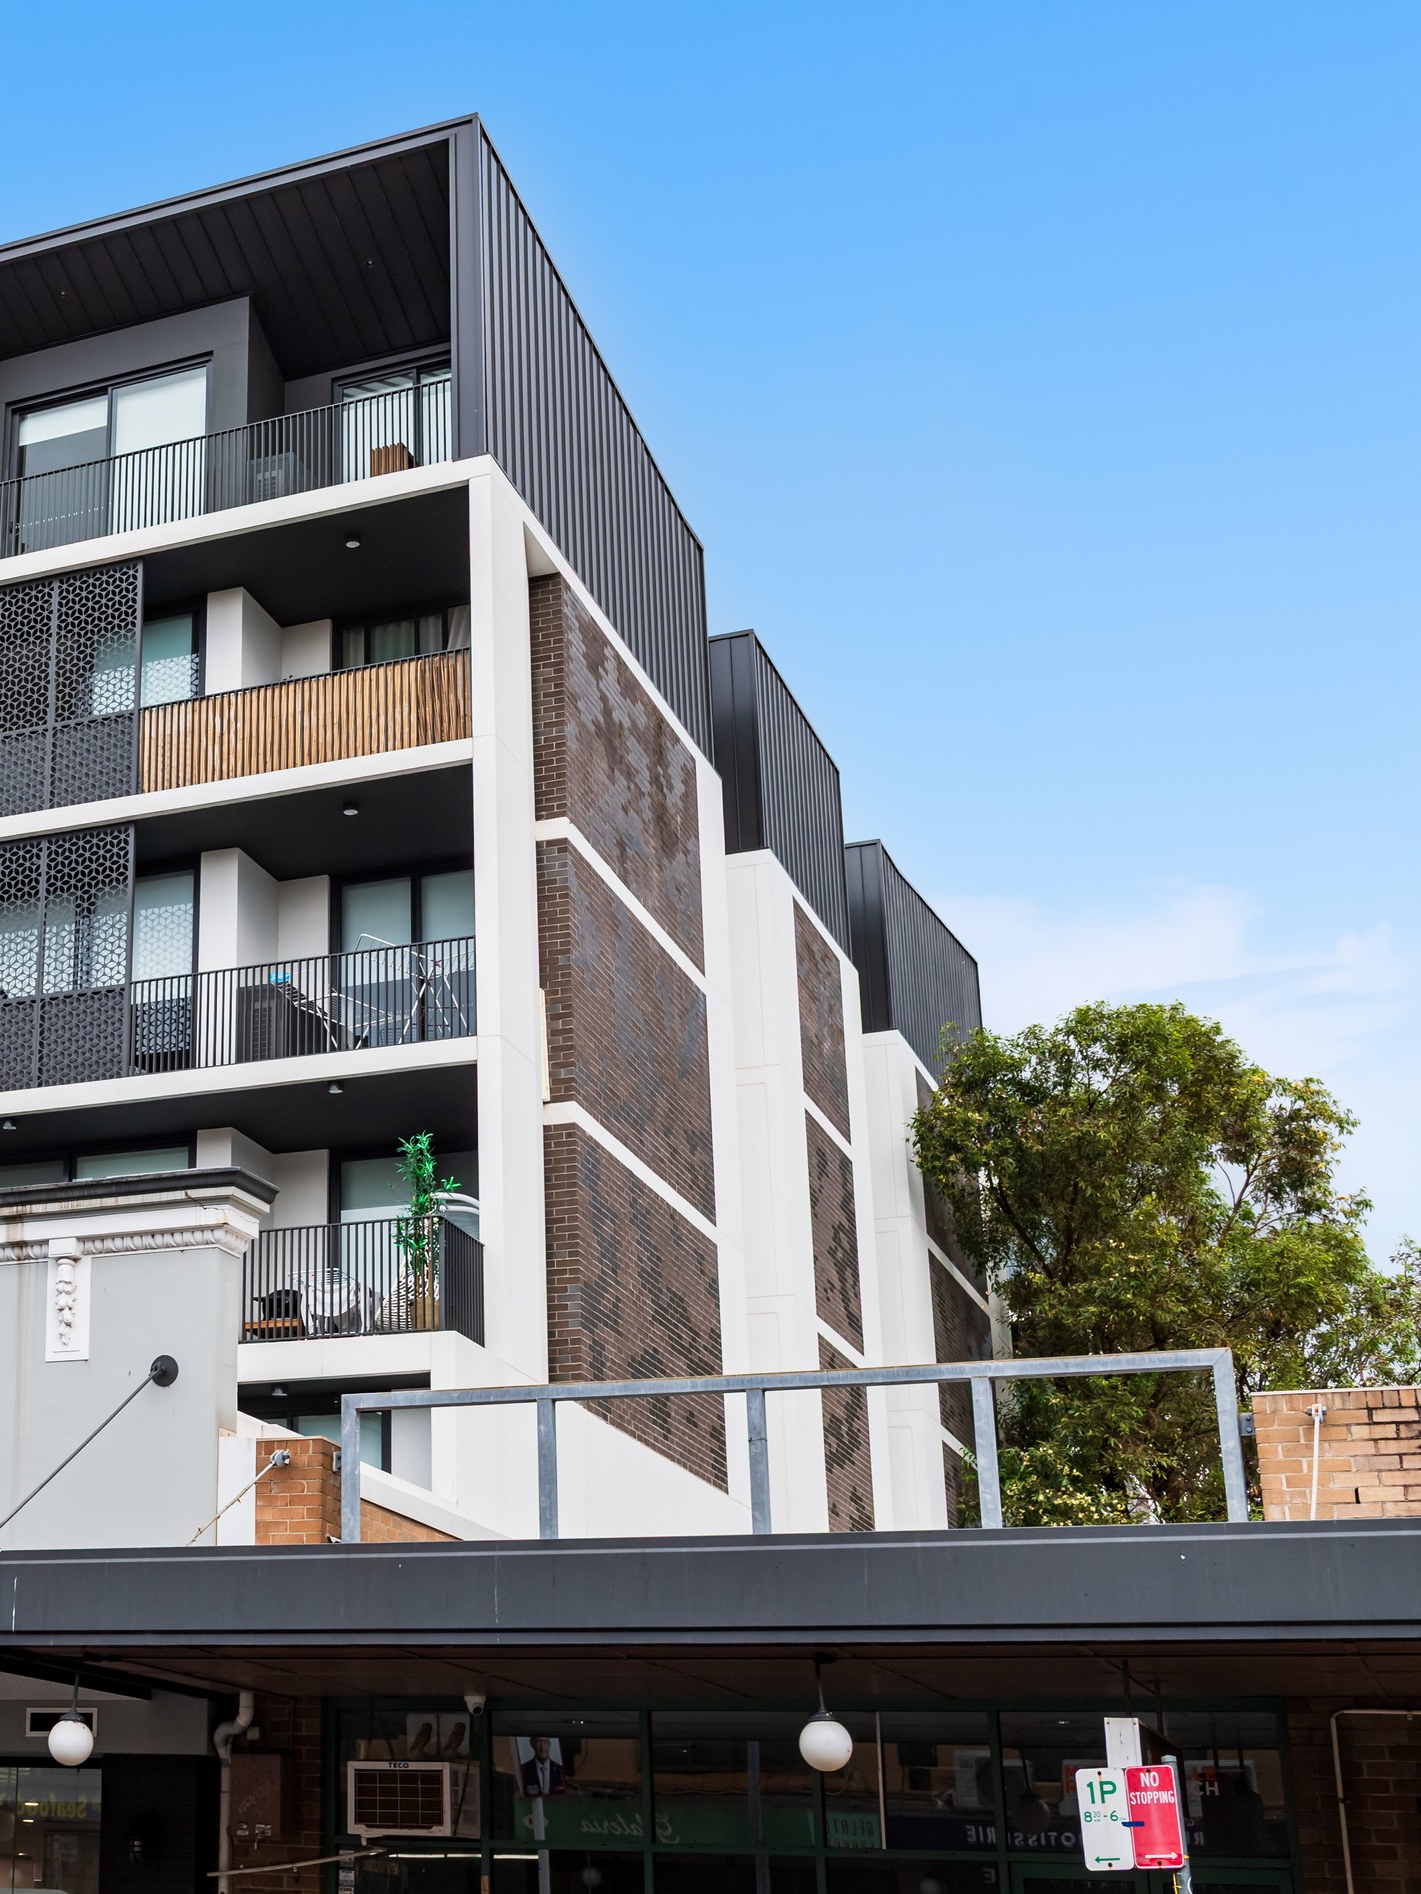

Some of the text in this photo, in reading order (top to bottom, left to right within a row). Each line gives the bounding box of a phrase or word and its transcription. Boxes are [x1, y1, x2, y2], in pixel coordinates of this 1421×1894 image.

[1140, 1771, 1160, 1788] NO
[1086, 1780, 1117, 1805] 1P
[1129, 1790, 1175, 1805] STOPPING
